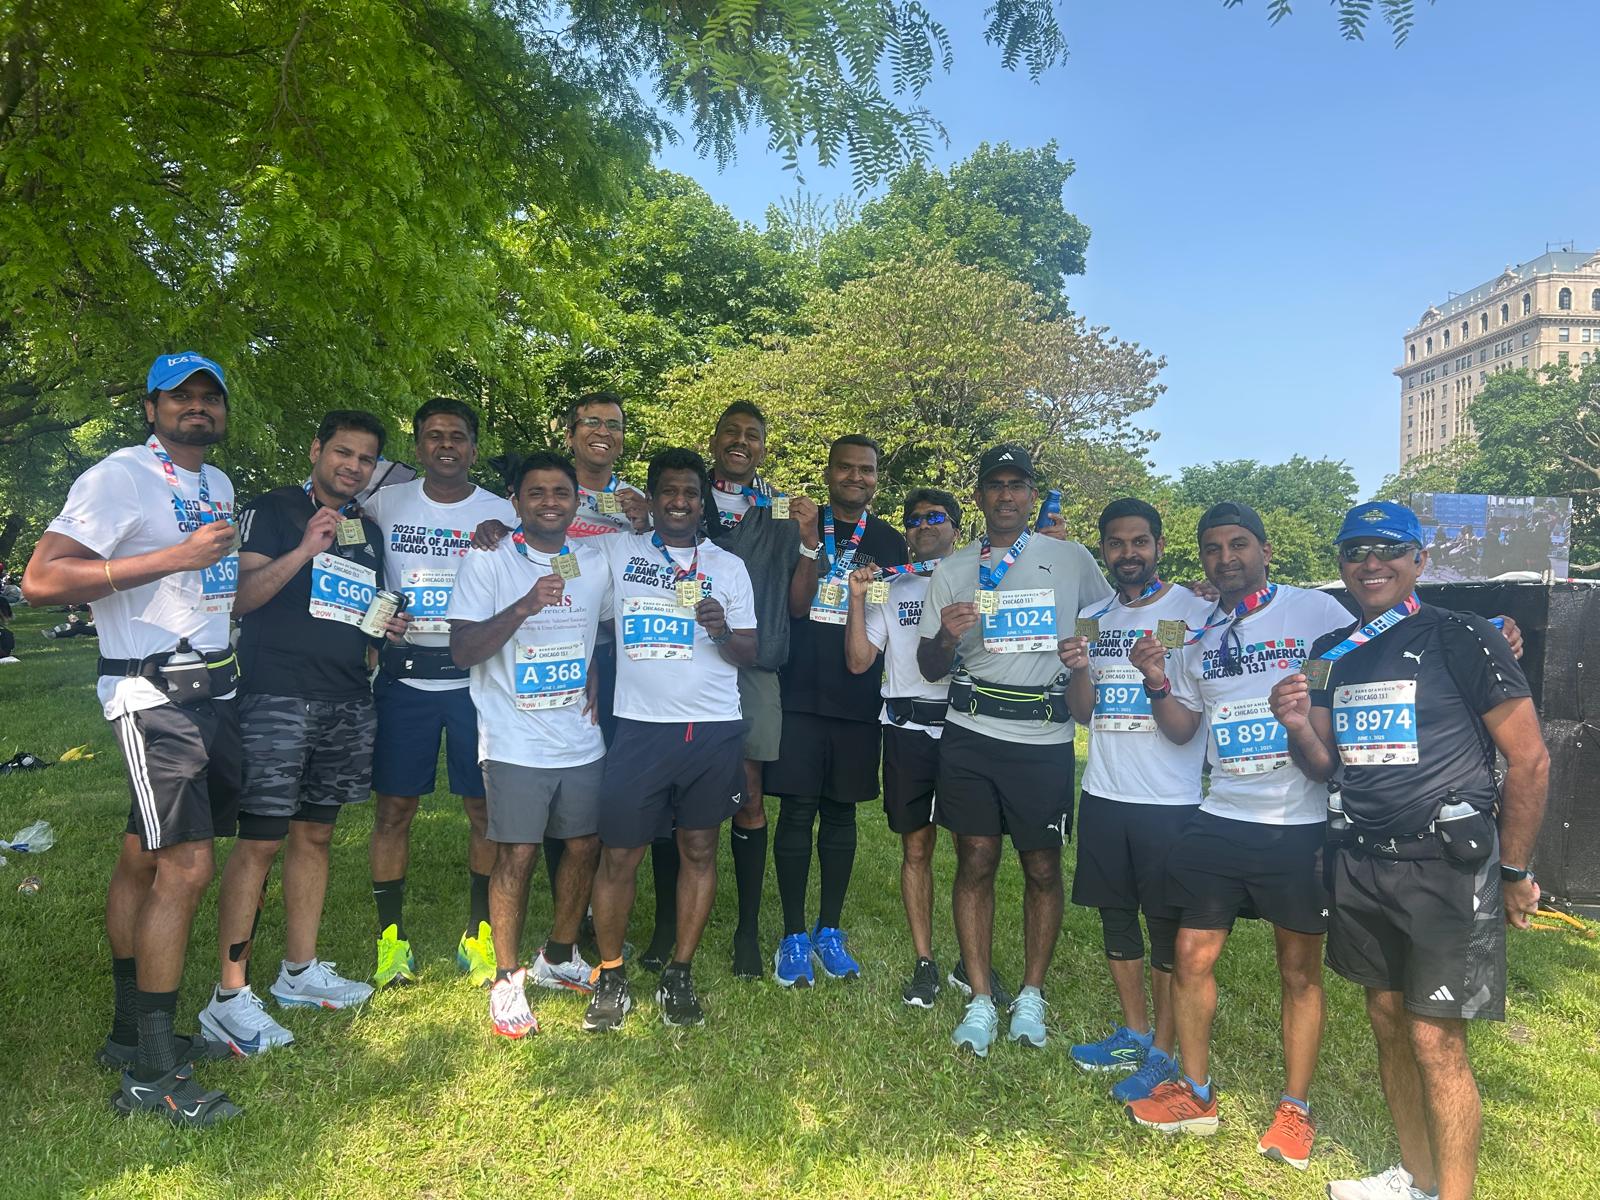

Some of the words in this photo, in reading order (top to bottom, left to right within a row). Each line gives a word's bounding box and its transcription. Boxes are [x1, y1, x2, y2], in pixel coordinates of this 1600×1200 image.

[392, 523, 416, 534] 2025
[400, 533, 426, 545] BANK
[428, 537, 441, 546] OF
[442, 538, 471, 549] AMER
[390, 542, 428, 555] CHICAGO
[431, 546, 449, 557] 13.1
[205, 566, 217, 583] A
[634, 565, 658, 577] BANK
[622, 573, 659, 587] CHICAGO
[320, 574, 332, 593] C
[337, 580, 373, 605] 660
[422, 590, 452, 607] 89
[898, 600, 920, 610] 2025
[985, 613, 998, 629] E
[1004, 609, 1054, 628] 1024
[624, 618, 636, 635] E
[642, 617, 689, 636] 1041
[1097, 638, 1121, 648] BANK
[1122, 638, 1134, 647] OF
[1089, 647, 1123, 657] CHICAGO
[1202, 649, 1220, 661] 202
[1257, 648, 1307, 662] AMERICA
[522, 666, 539, 685] A
[545, 662, 582, 683] 368
[1246, 661, 1267, 674] 13.1
[1104, 687, 1151, 705] 897
[1354, 694, 1378, 702] CHICAGO
[1234, 709, 1259, 717] CHICAGO
[1335, 712, 1349, 732] B
[1355, 708, 1413, 731] 8974
[1216, 727, 1231, 746] B
